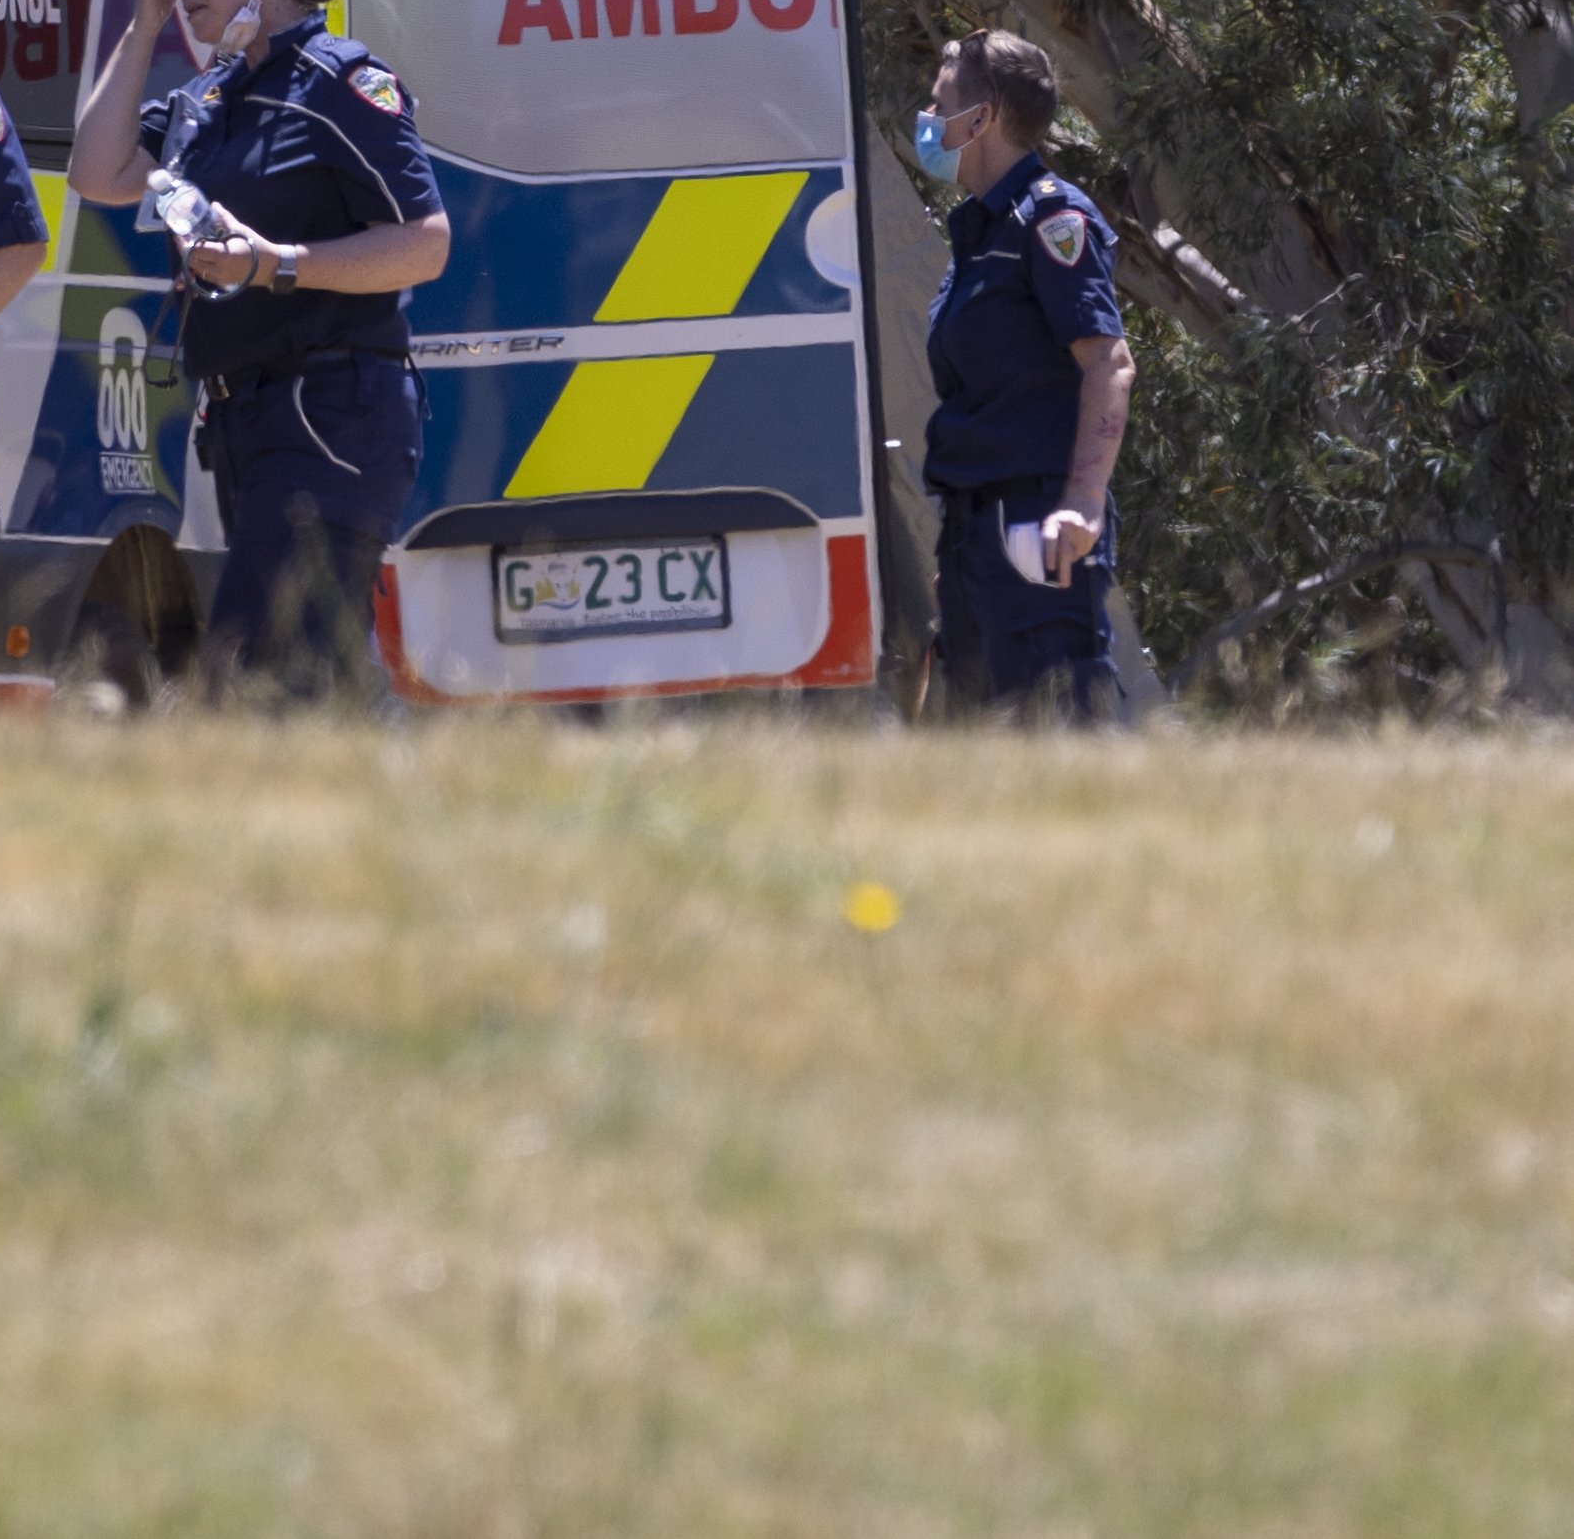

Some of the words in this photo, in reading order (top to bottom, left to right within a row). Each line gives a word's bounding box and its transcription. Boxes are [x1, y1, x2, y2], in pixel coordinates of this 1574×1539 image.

[408, 333, 565, 357] RINTER
[97, 367, 149, 451] 000
[505, 560, 535, 611] G
